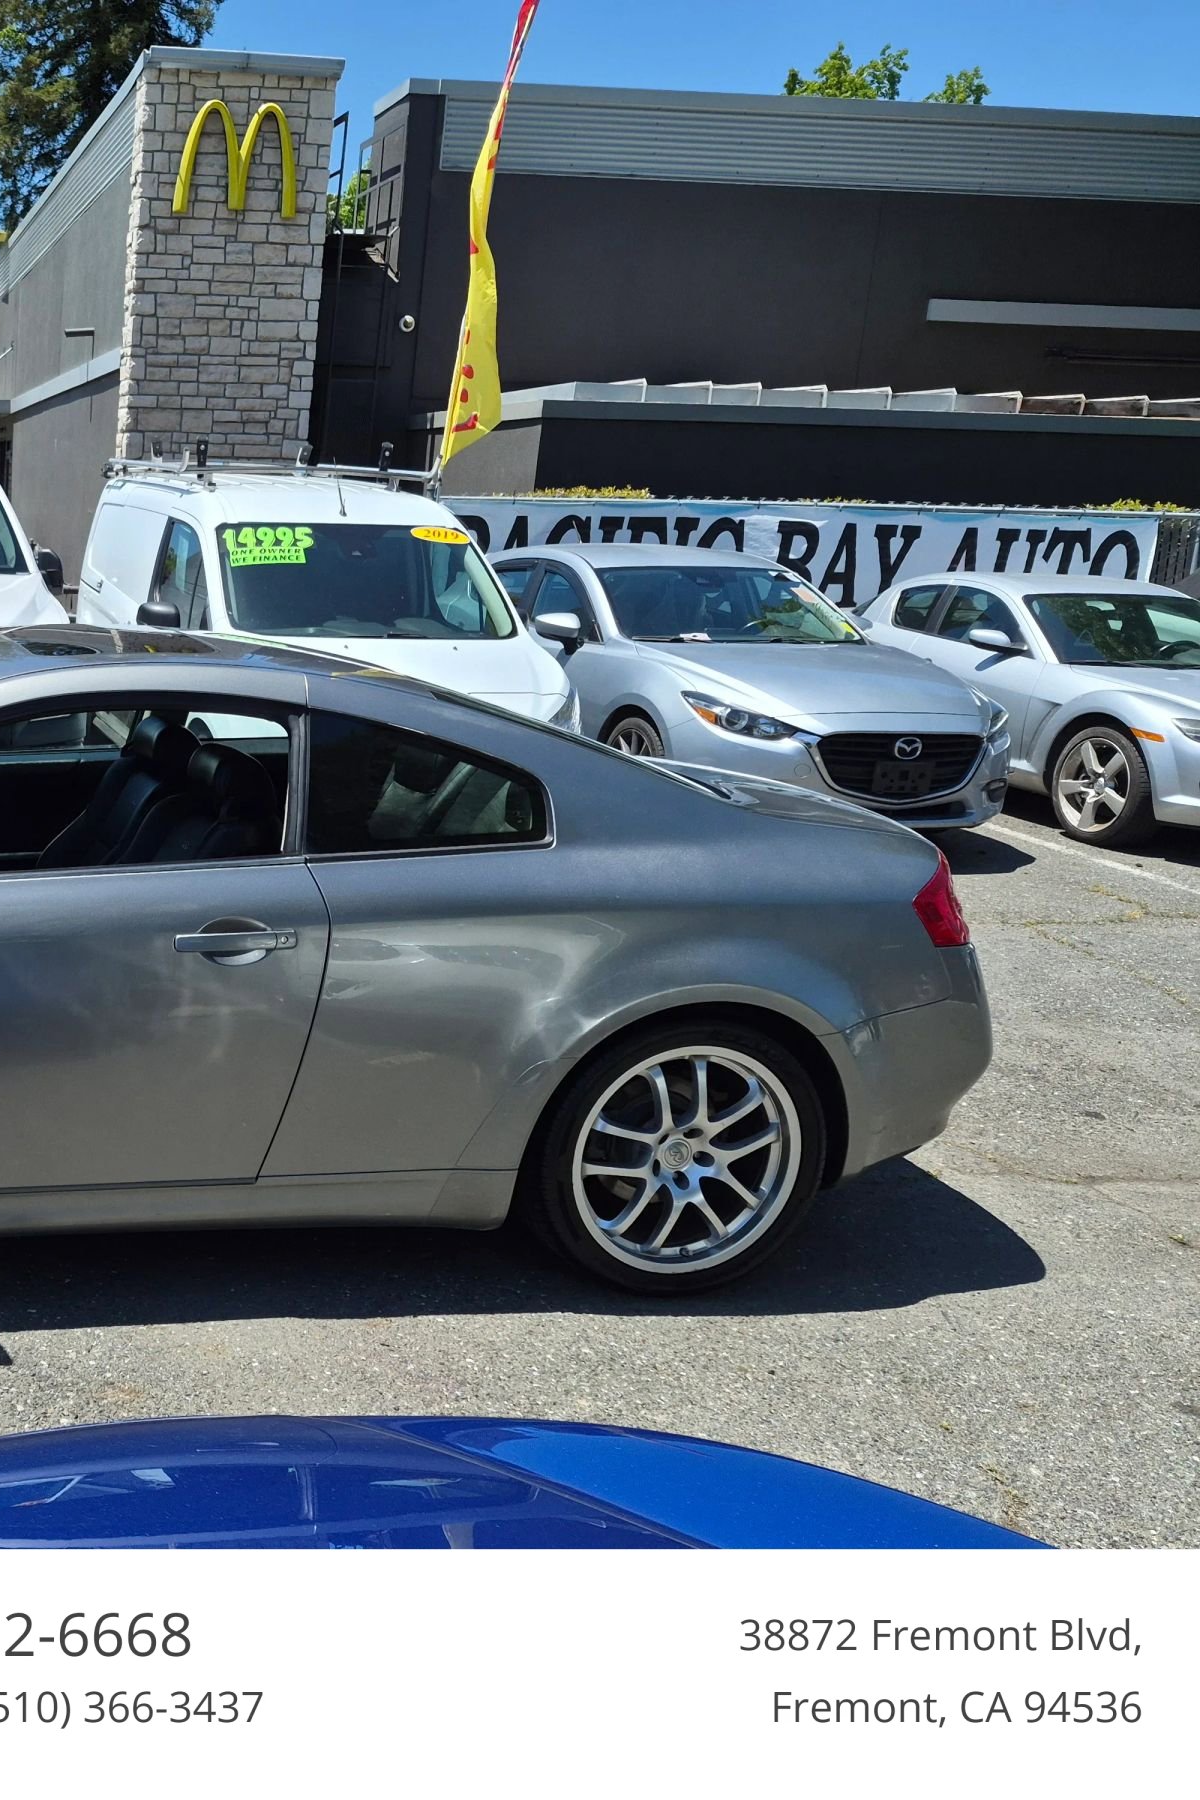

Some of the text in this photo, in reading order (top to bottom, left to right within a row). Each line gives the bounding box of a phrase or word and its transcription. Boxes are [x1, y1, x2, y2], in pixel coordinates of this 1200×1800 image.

[222, 526, 314, 551] 14995
[423, 529, 460, 540] 2019
[231, 548, 255, 556] ONE
[231, 554, 301, 564] WE FINANCE
[776, 520, 922, 608] BAY
